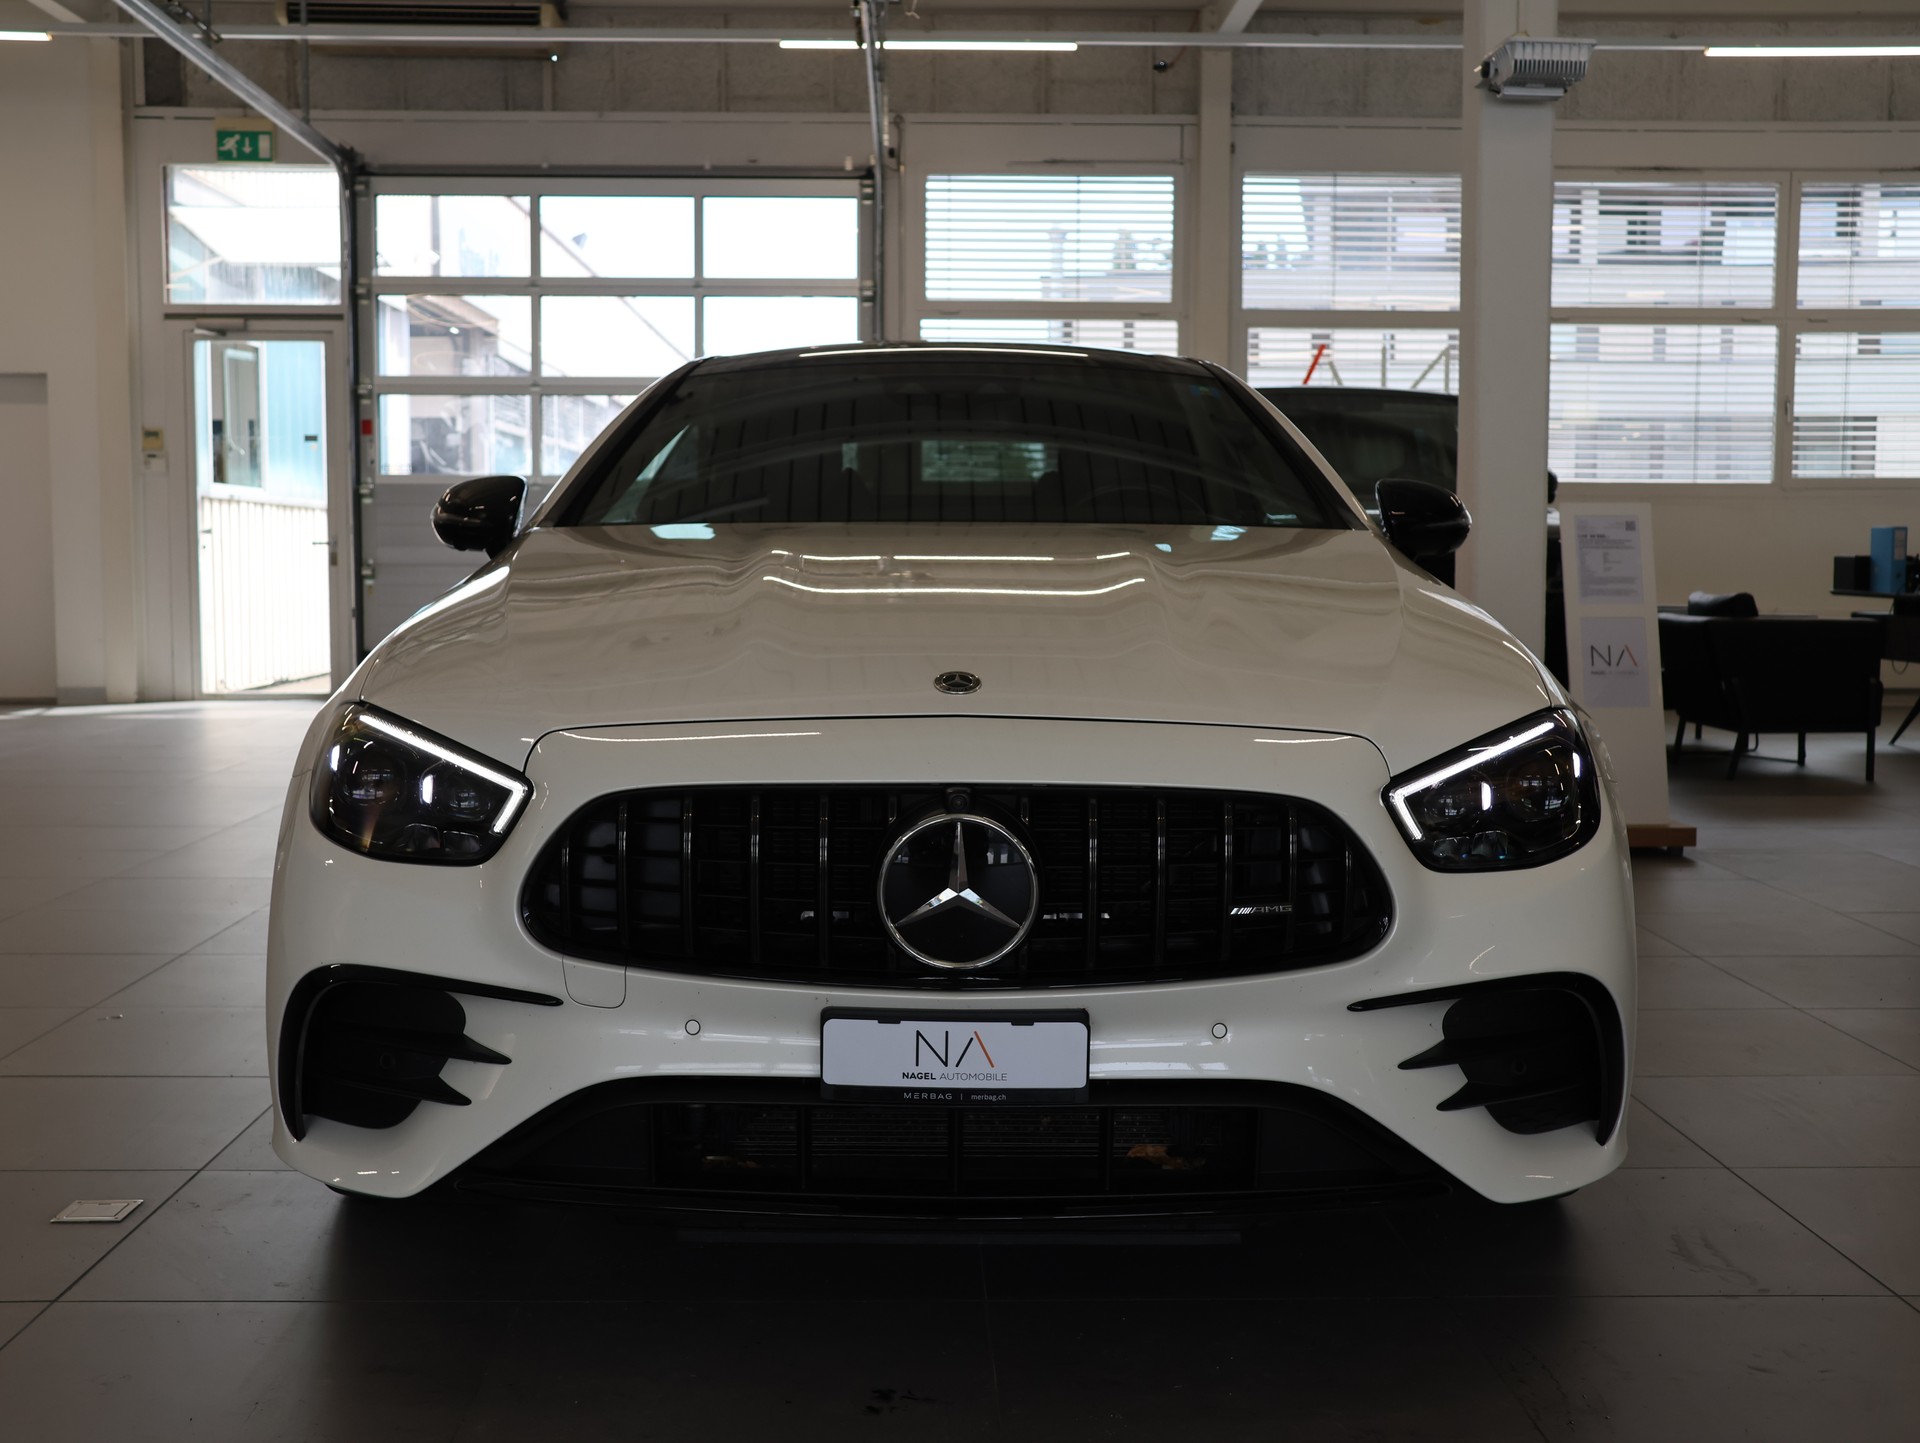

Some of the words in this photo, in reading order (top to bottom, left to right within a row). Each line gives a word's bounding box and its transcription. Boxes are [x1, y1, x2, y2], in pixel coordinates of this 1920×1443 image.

[1250, 904, 1293, 914] AMG
[916, 1029, 995, 1068] NA
[902, 1071, 937, 1081] NAGEL
[939, 1072, 1008, 1082] AUTOMOBILE
[903, 1092, 953, 1100] MERBAG
[970, 1093, 1007, 1102] merbag.ch
